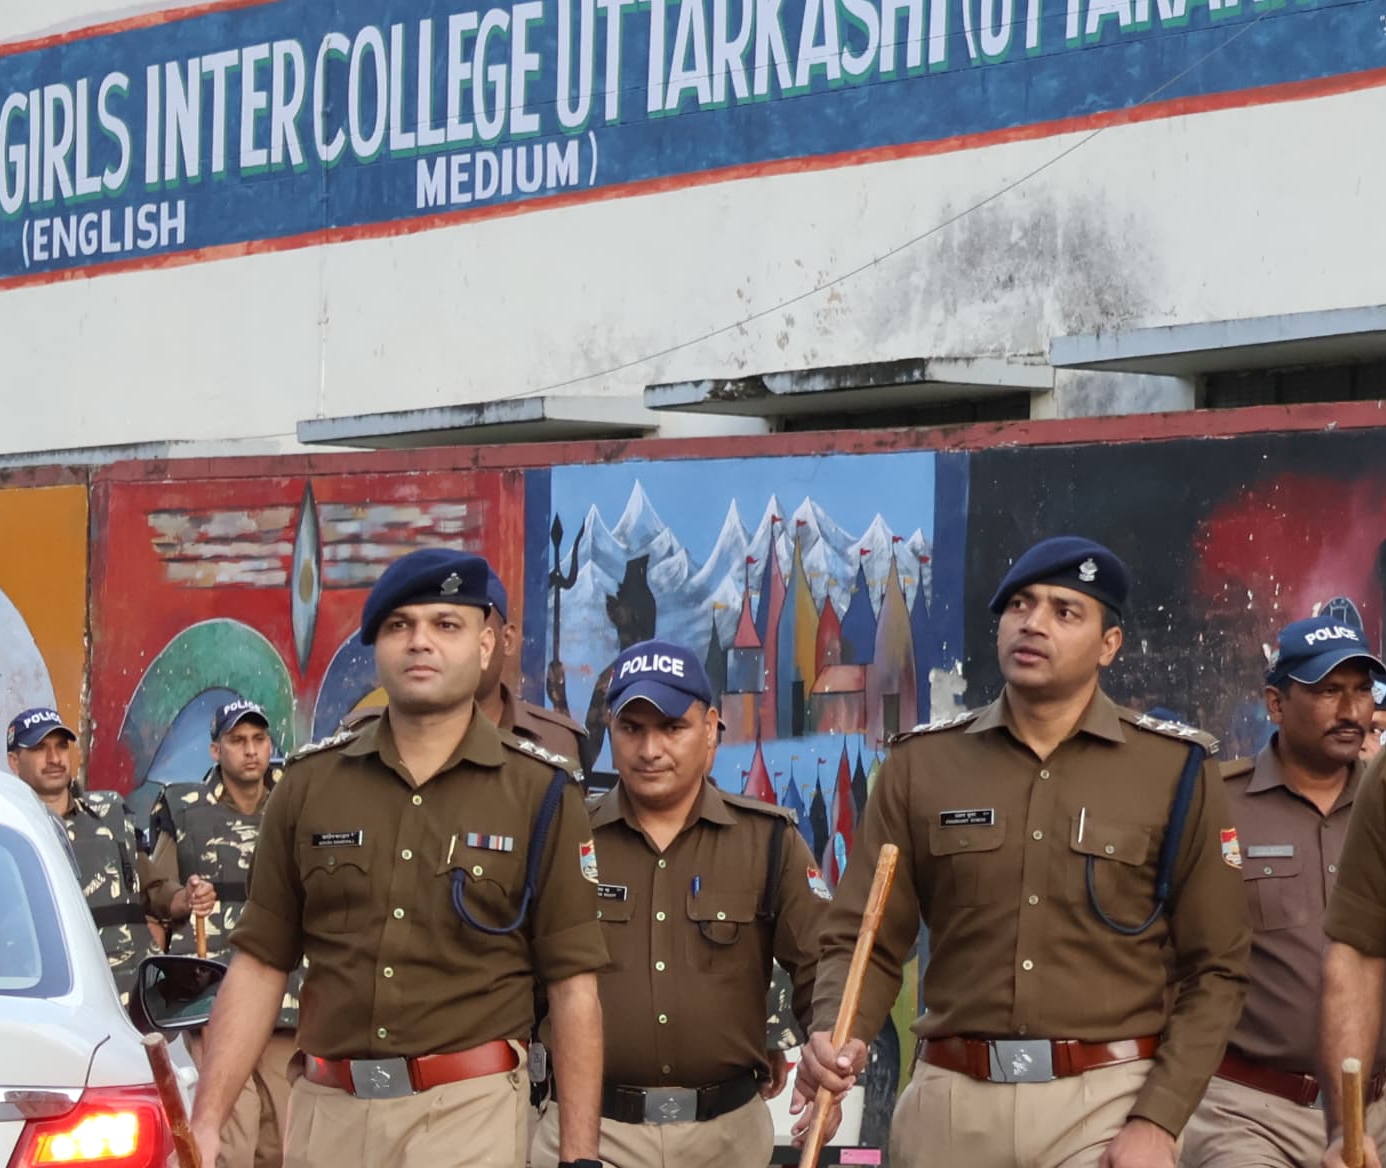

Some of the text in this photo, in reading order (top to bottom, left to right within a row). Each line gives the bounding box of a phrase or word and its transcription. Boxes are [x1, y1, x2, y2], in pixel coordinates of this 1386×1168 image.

[145, 38, 306, 184] INTER
[313, 0, 541, 161] COLLEGE
[22, 200, 186, 268] (ENGLISH
[1304, 625, 1360, 646] POLICE
[619, 653, 685, 680] POLICE
